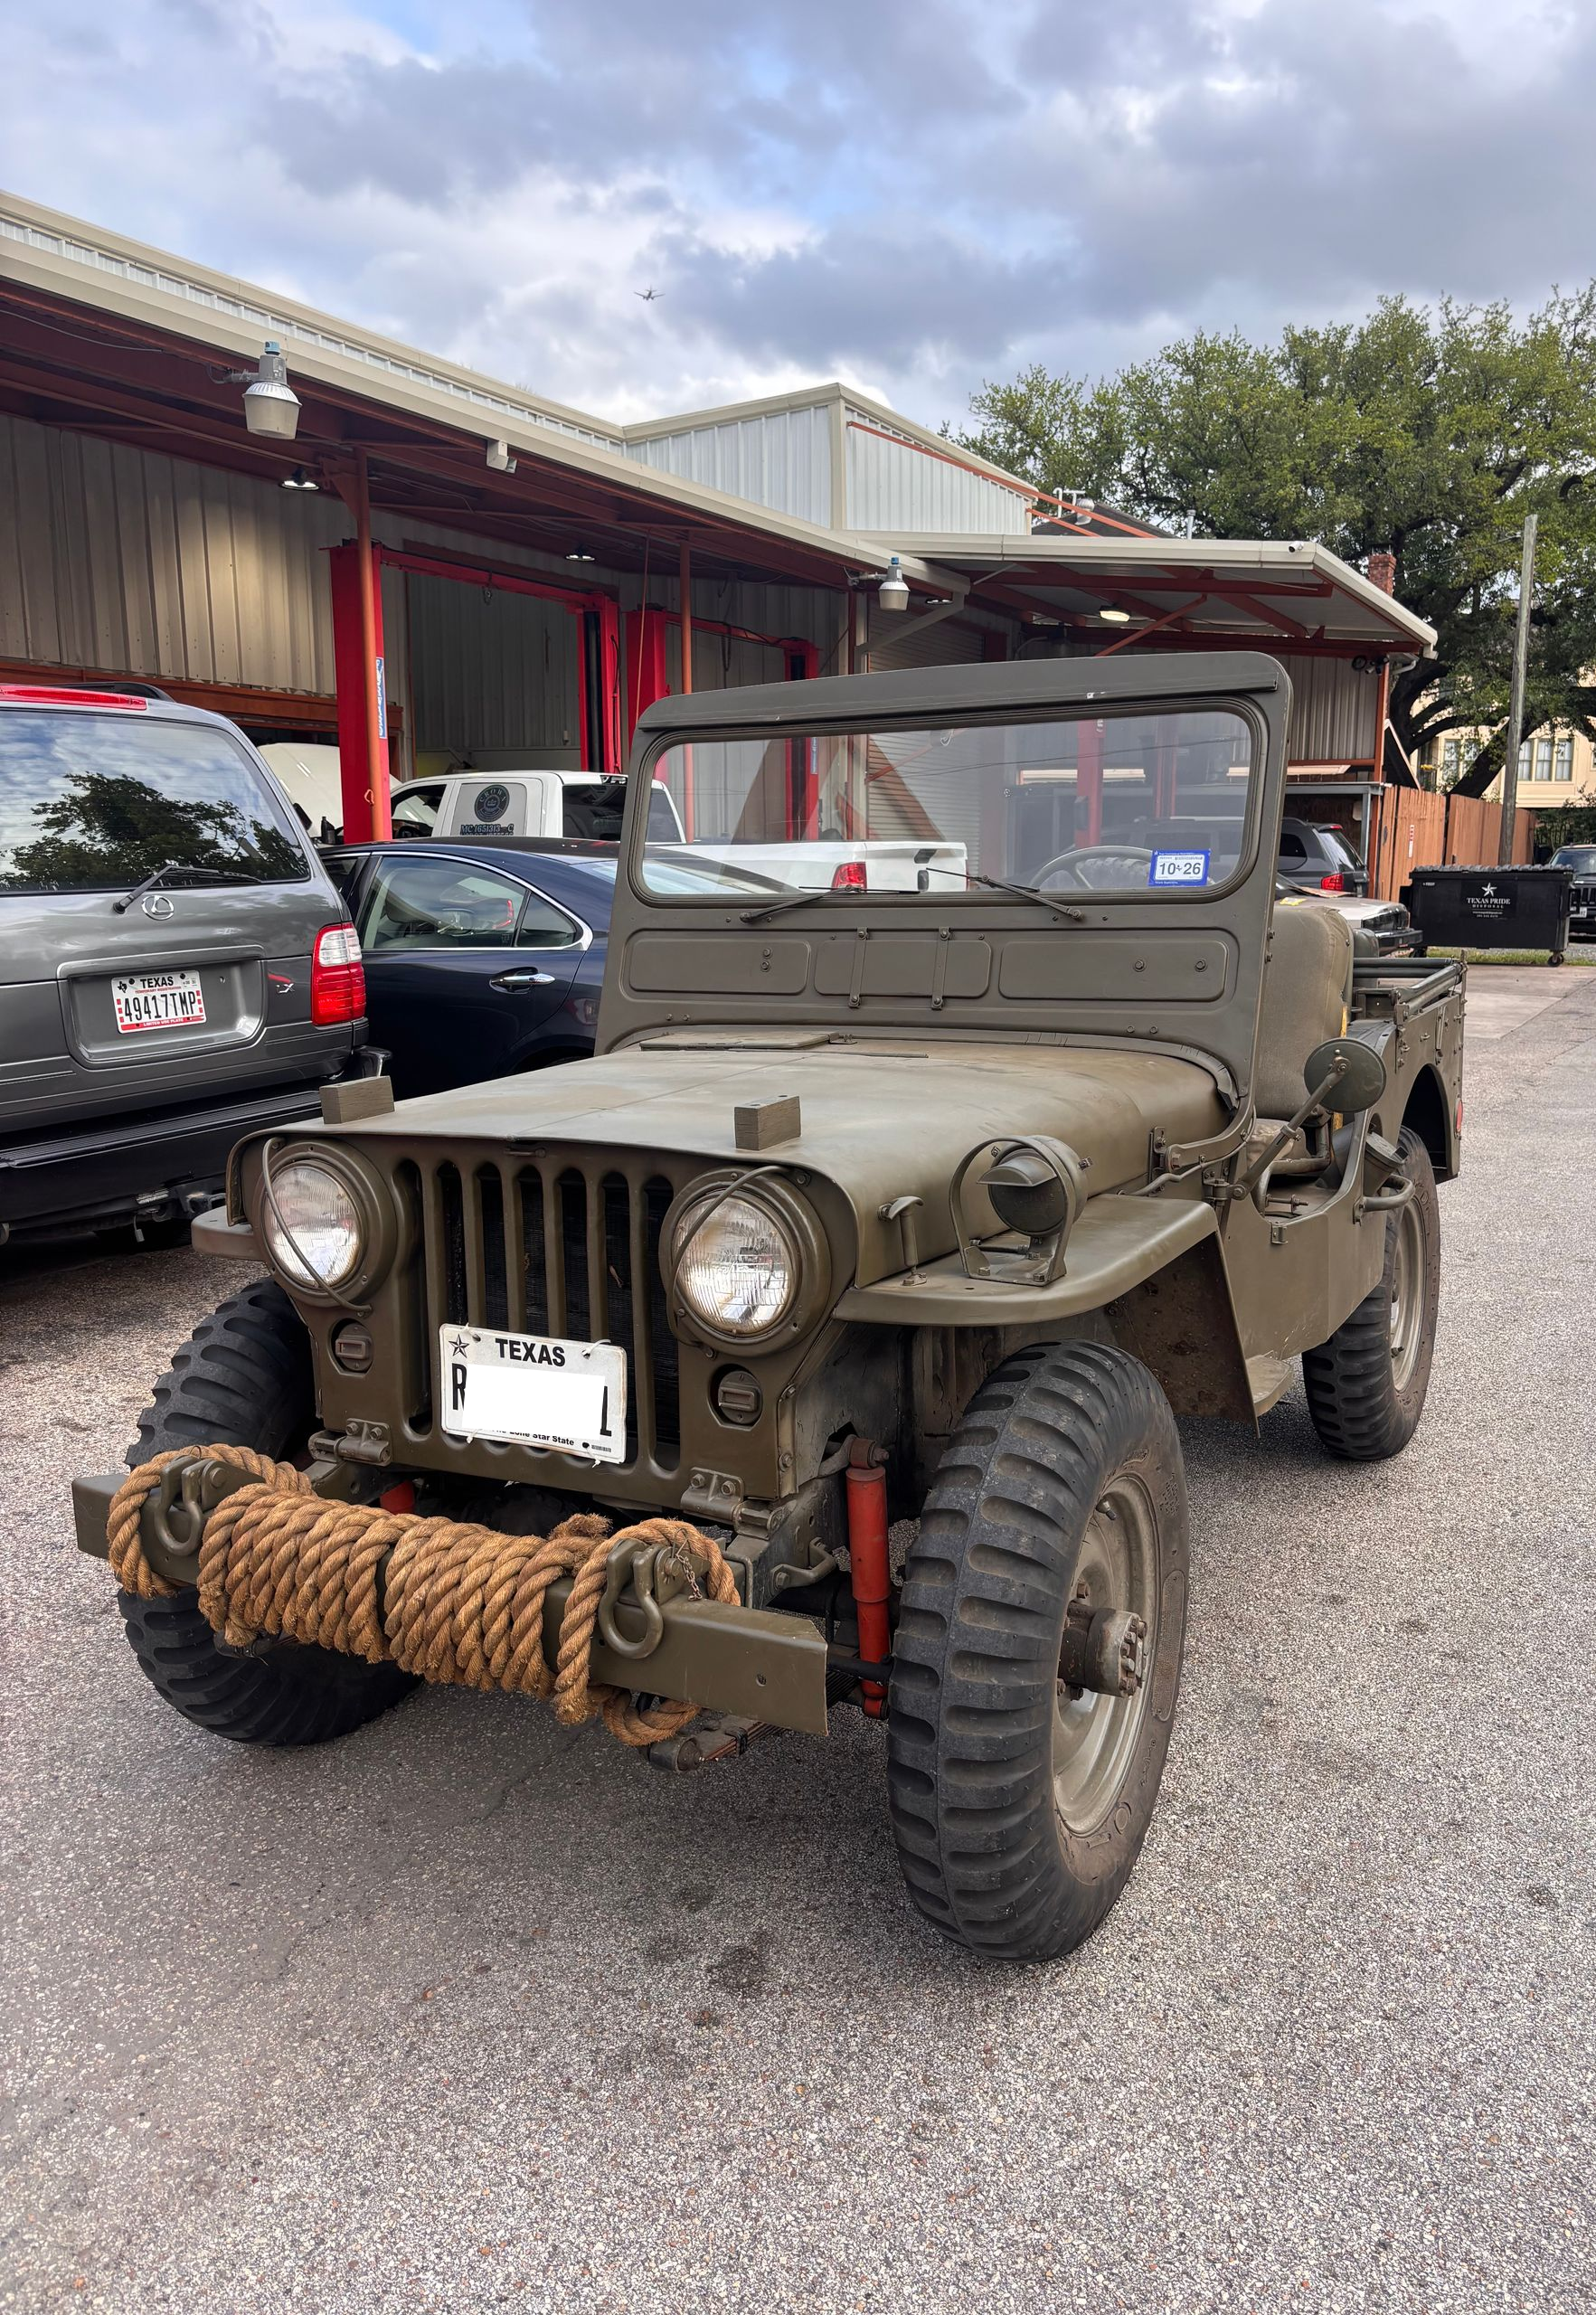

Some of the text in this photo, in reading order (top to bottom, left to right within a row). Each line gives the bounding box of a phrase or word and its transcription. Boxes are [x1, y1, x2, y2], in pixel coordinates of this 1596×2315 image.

[1159, 862, 1201, 875] 10 26
[140, 976, 174, 988] TEXAS
[124, 991, 196, 1022] 49417TMP
[495, 1337, 566, 1367] TEXAS
[552, 1435, 574, 1446] State
